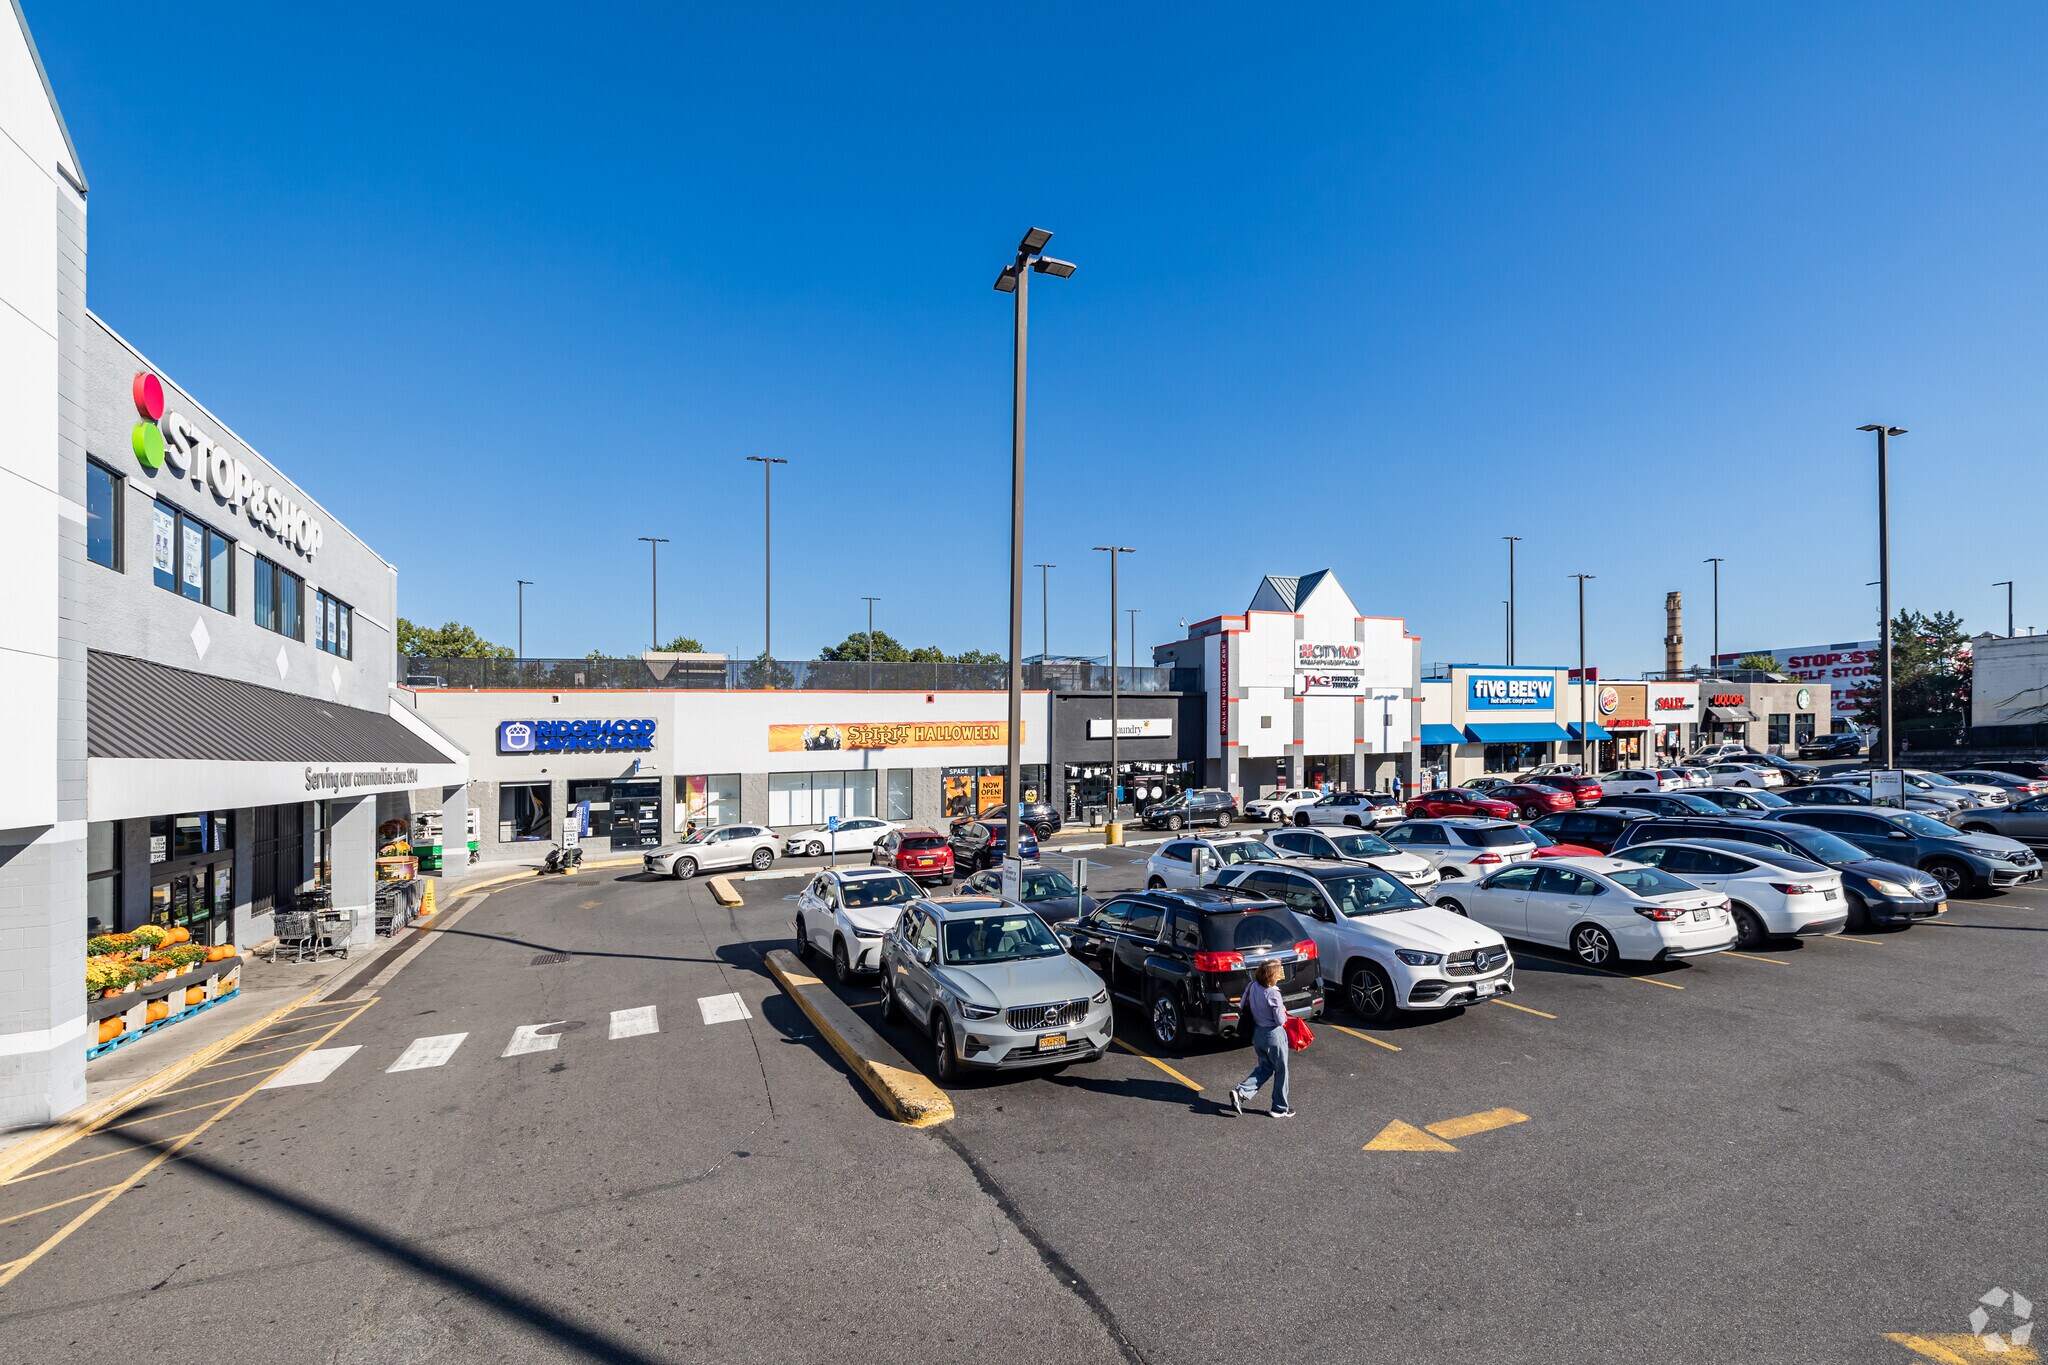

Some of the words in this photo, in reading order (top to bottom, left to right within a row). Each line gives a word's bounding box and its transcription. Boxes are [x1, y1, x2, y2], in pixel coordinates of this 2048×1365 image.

[1313, 645, 1361, 659] CITYMD
[1301, 675, 1330, 694] JAG
[1656, 697, 1685, 710] SALLY
[1713, 693, 1745, 706] LIQUORS
[536, 719, 656, 737] RIDGEWOOD
[848, 724, 911, 746] SPIRIT
[915, 725, 999, 741] HALLOWEEN
[1115, 724, 1142, 736] aundry
[536, 735, 608, 751] SAVINGS
[610, 735, 655, 749] BANK
[305, 766, 339, 794] Serving
[340, 772, 353, 788] our
[353, 767, 393, 787] communities
[393, 767, 406, 785] since
[980, 788, 1002, 796] OPEN!
